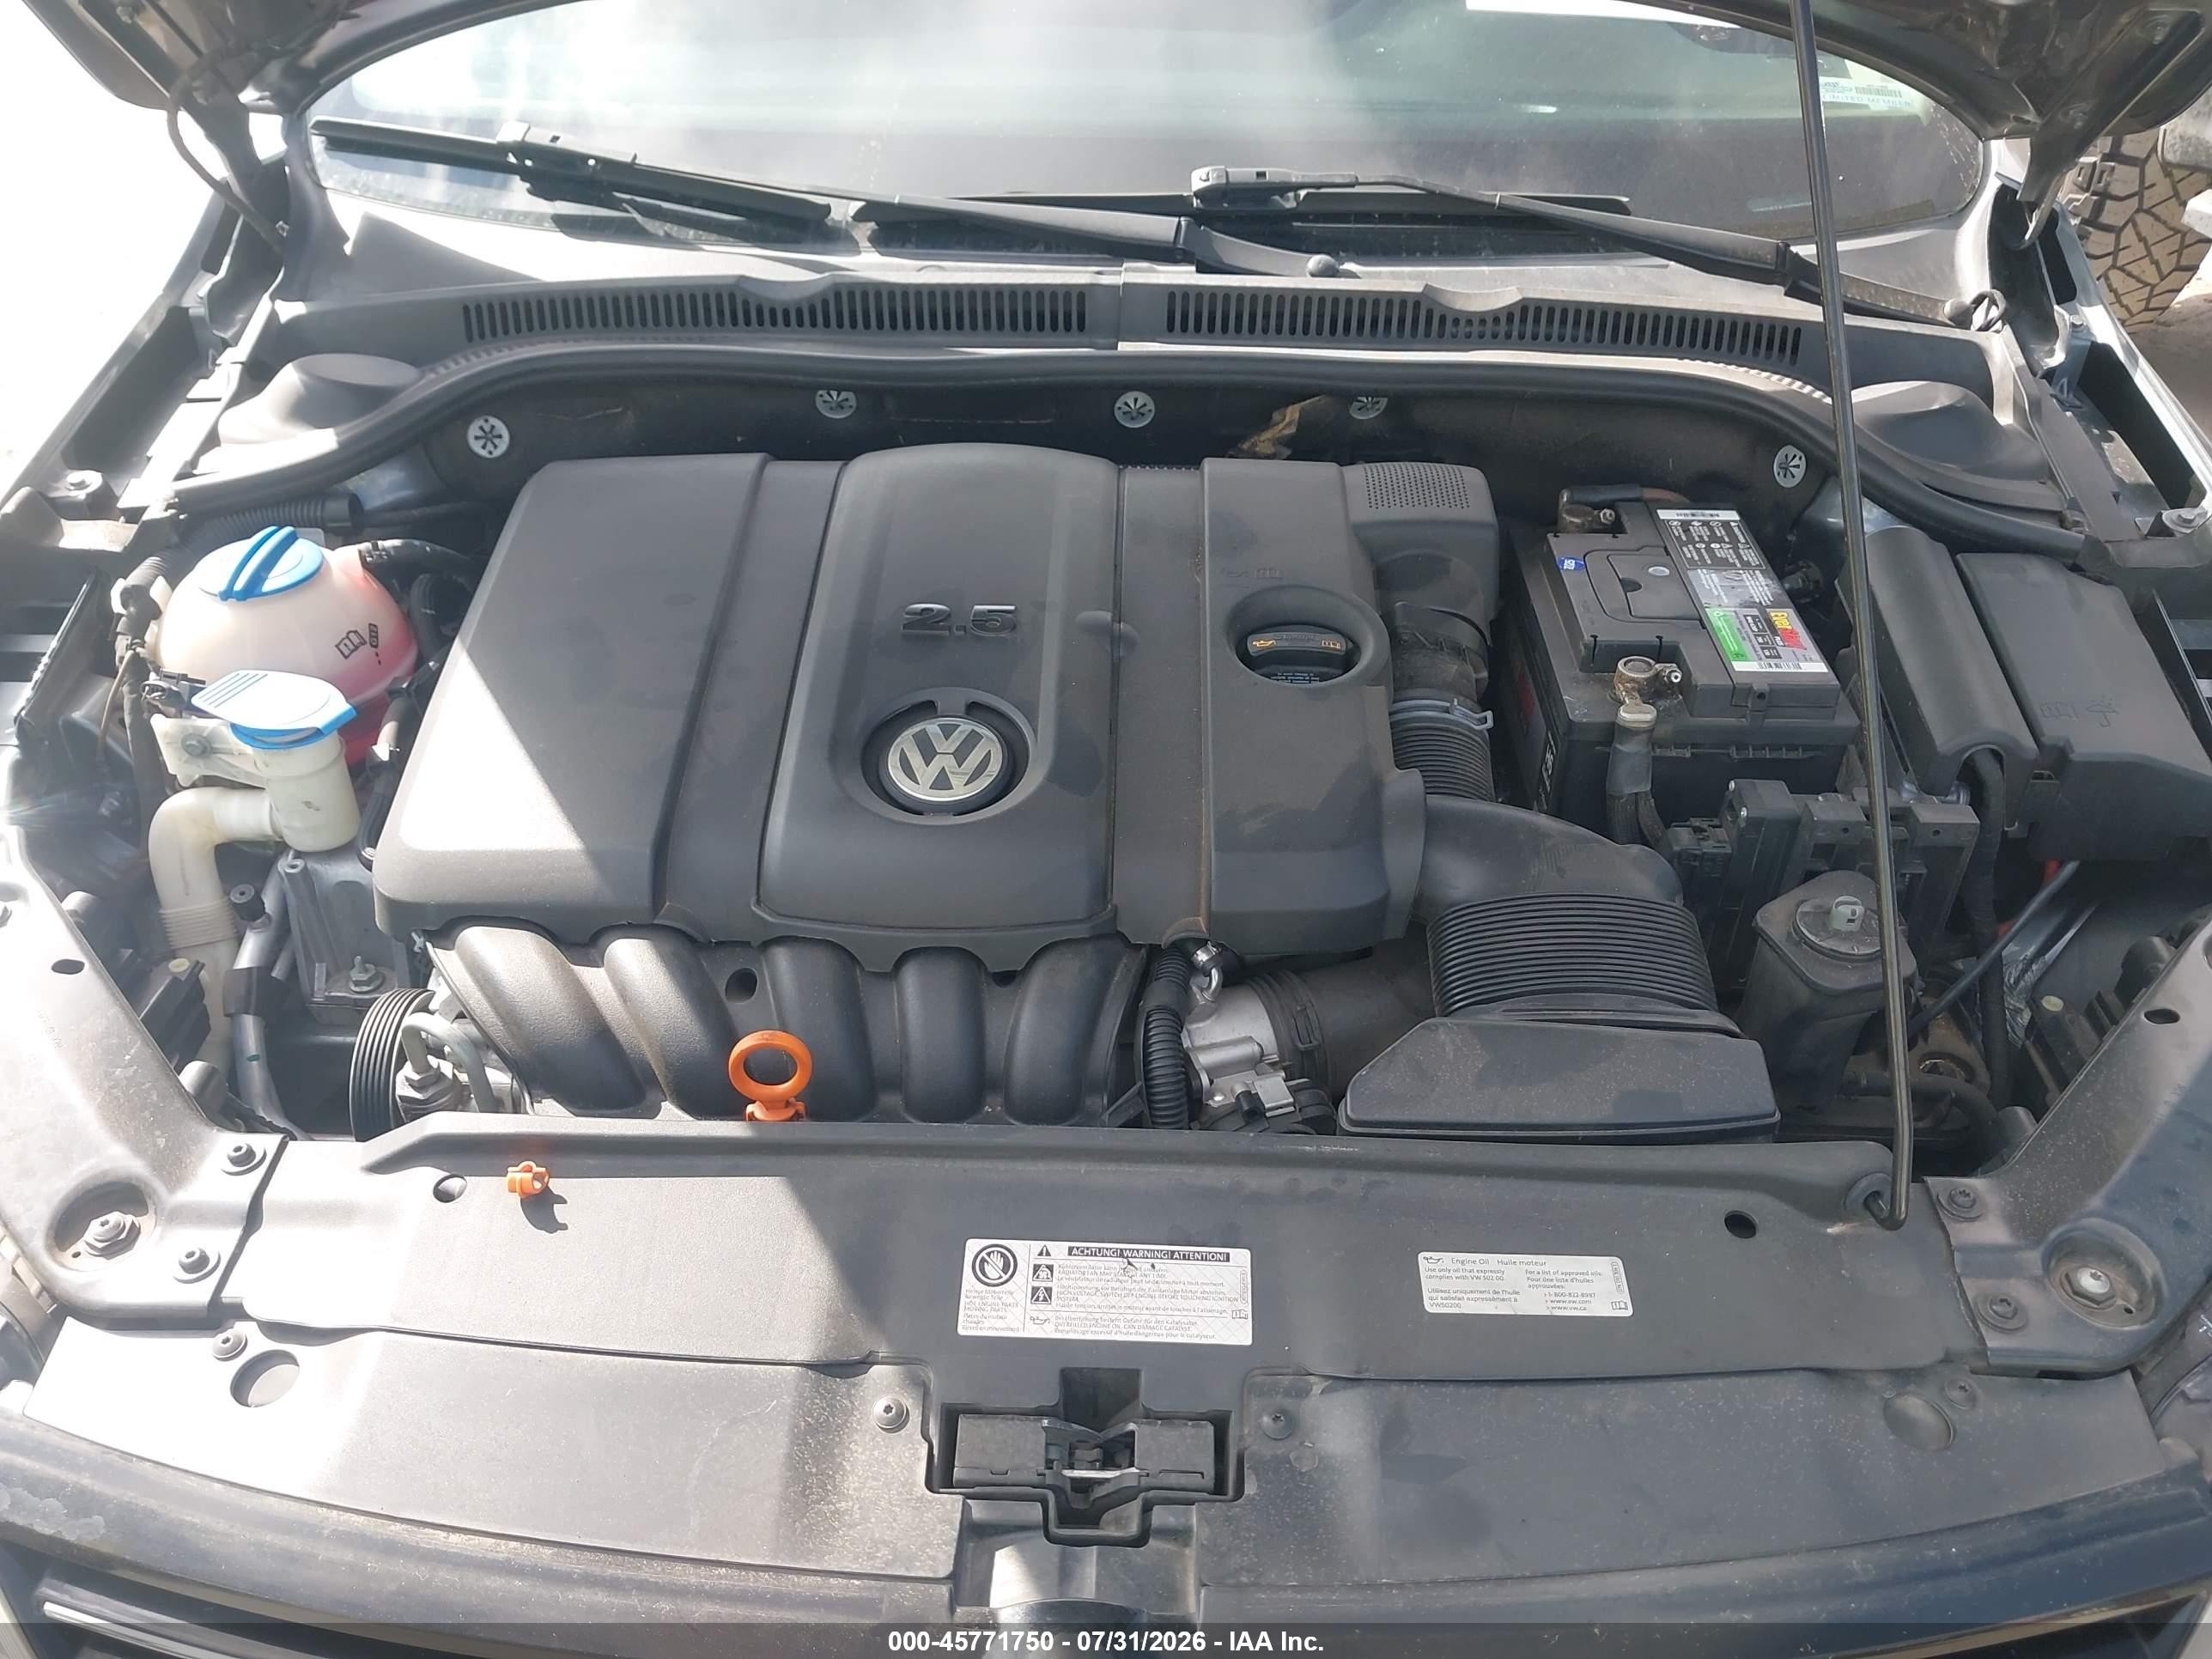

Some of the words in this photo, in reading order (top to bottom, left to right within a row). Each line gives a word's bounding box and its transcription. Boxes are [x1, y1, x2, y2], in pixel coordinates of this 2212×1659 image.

[902, 603, 1018, 637] 2.5
[1071, 1247, 1120, 1256] ACHTUNG!
[1122, 1249, 1170, 1259] WARNING!
[1173, 1251, 1226, 1261] ATTENTION!
